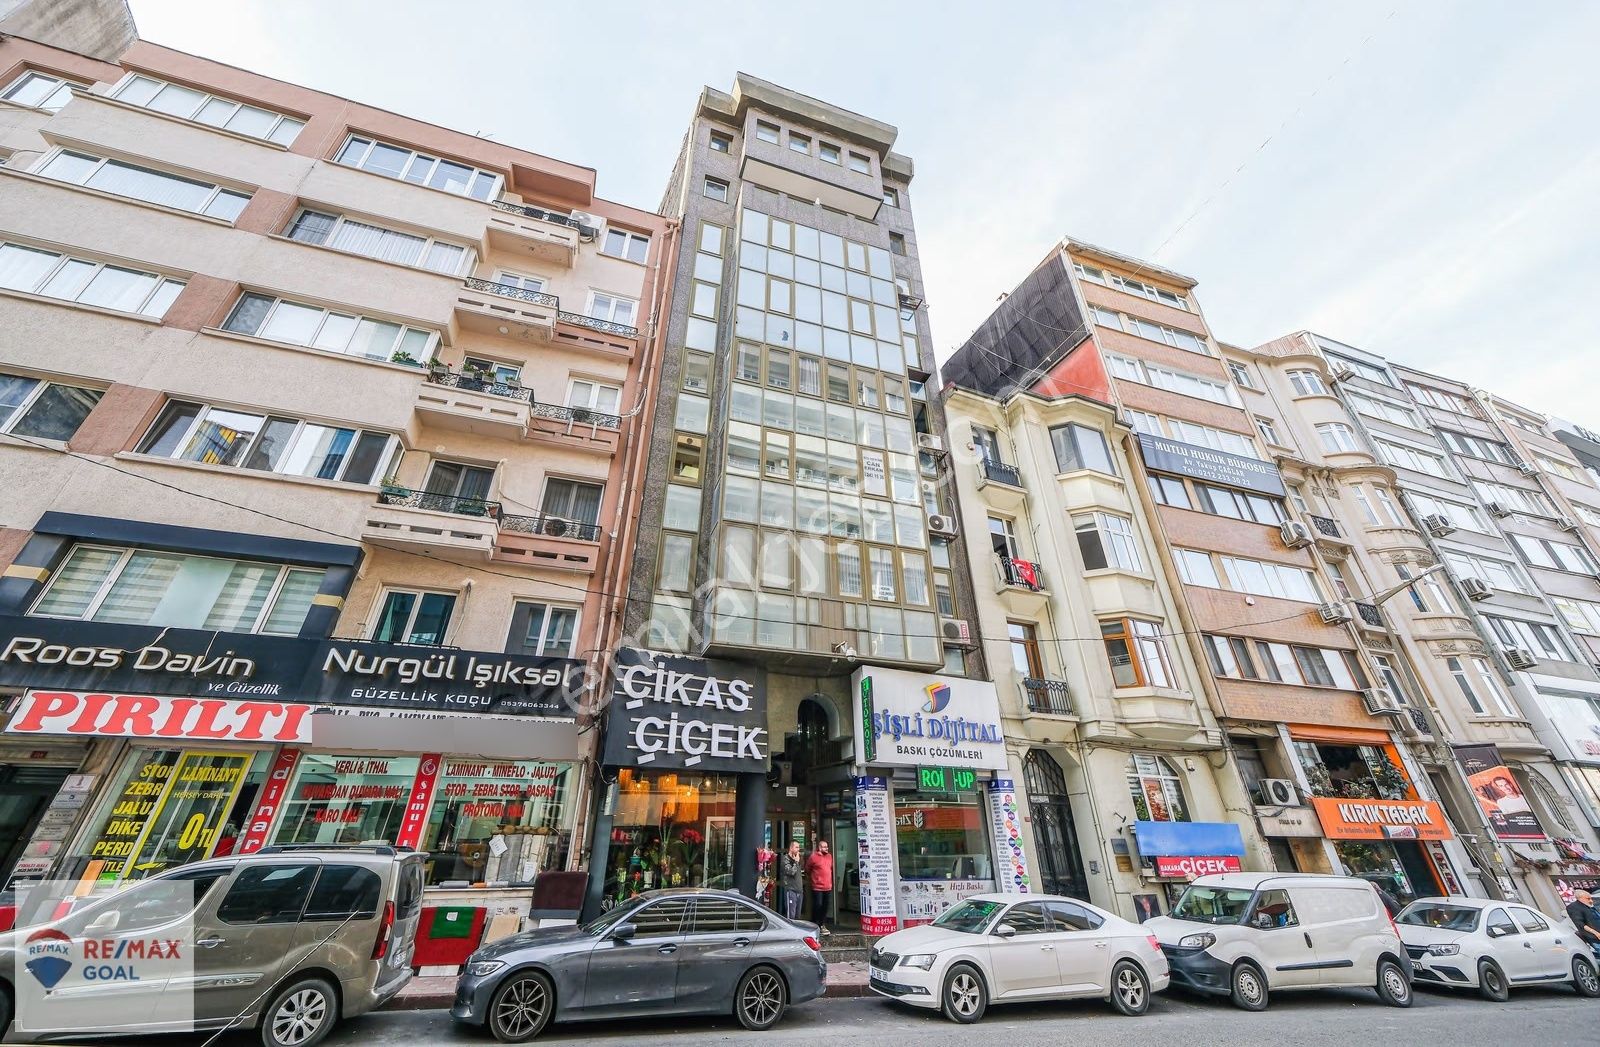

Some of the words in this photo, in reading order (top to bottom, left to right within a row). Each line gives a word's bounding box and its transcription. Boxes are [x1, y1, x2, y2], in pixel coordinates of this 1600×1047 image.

[1154, 441, 1188, 456] MUTLU
[1190, 449, 1226, 465] HUKUK
[1227, 456, 1266, 474] BÜROSU
[1, 637, 122, 669] Roos
[133, 646, 255, 677] Davin
[322, 648, 455, 683] Nurgül
[464, 656, 571, 687] Işıksal
[208, 682, 224, 693] ve
[226, 680, 282, 696] Güzellik
[350, 687, 438, 702] GÜZELLİK
[444, 693, 492, 709] KOÇU
[624, 661, 751, 712] ÇİKAS
[13, 692, 311, 741] PIRILTI
[874, 709, 924, 741] ŞİŞLİ
[927, 715, 1003, 746] DİJİTAL
[635, 712, 763, 766] ÇİÇEK
[896, 745, 926, 755] BASKI
[929, 746, 983, 760] ÇÖZÜMLERİ
[472, 784, 498, 797] ZEBRA
[1338, 803, 1433, 826] KIRIKTABAK
[1180, 857, 1229, 875] ÇİÇEK
